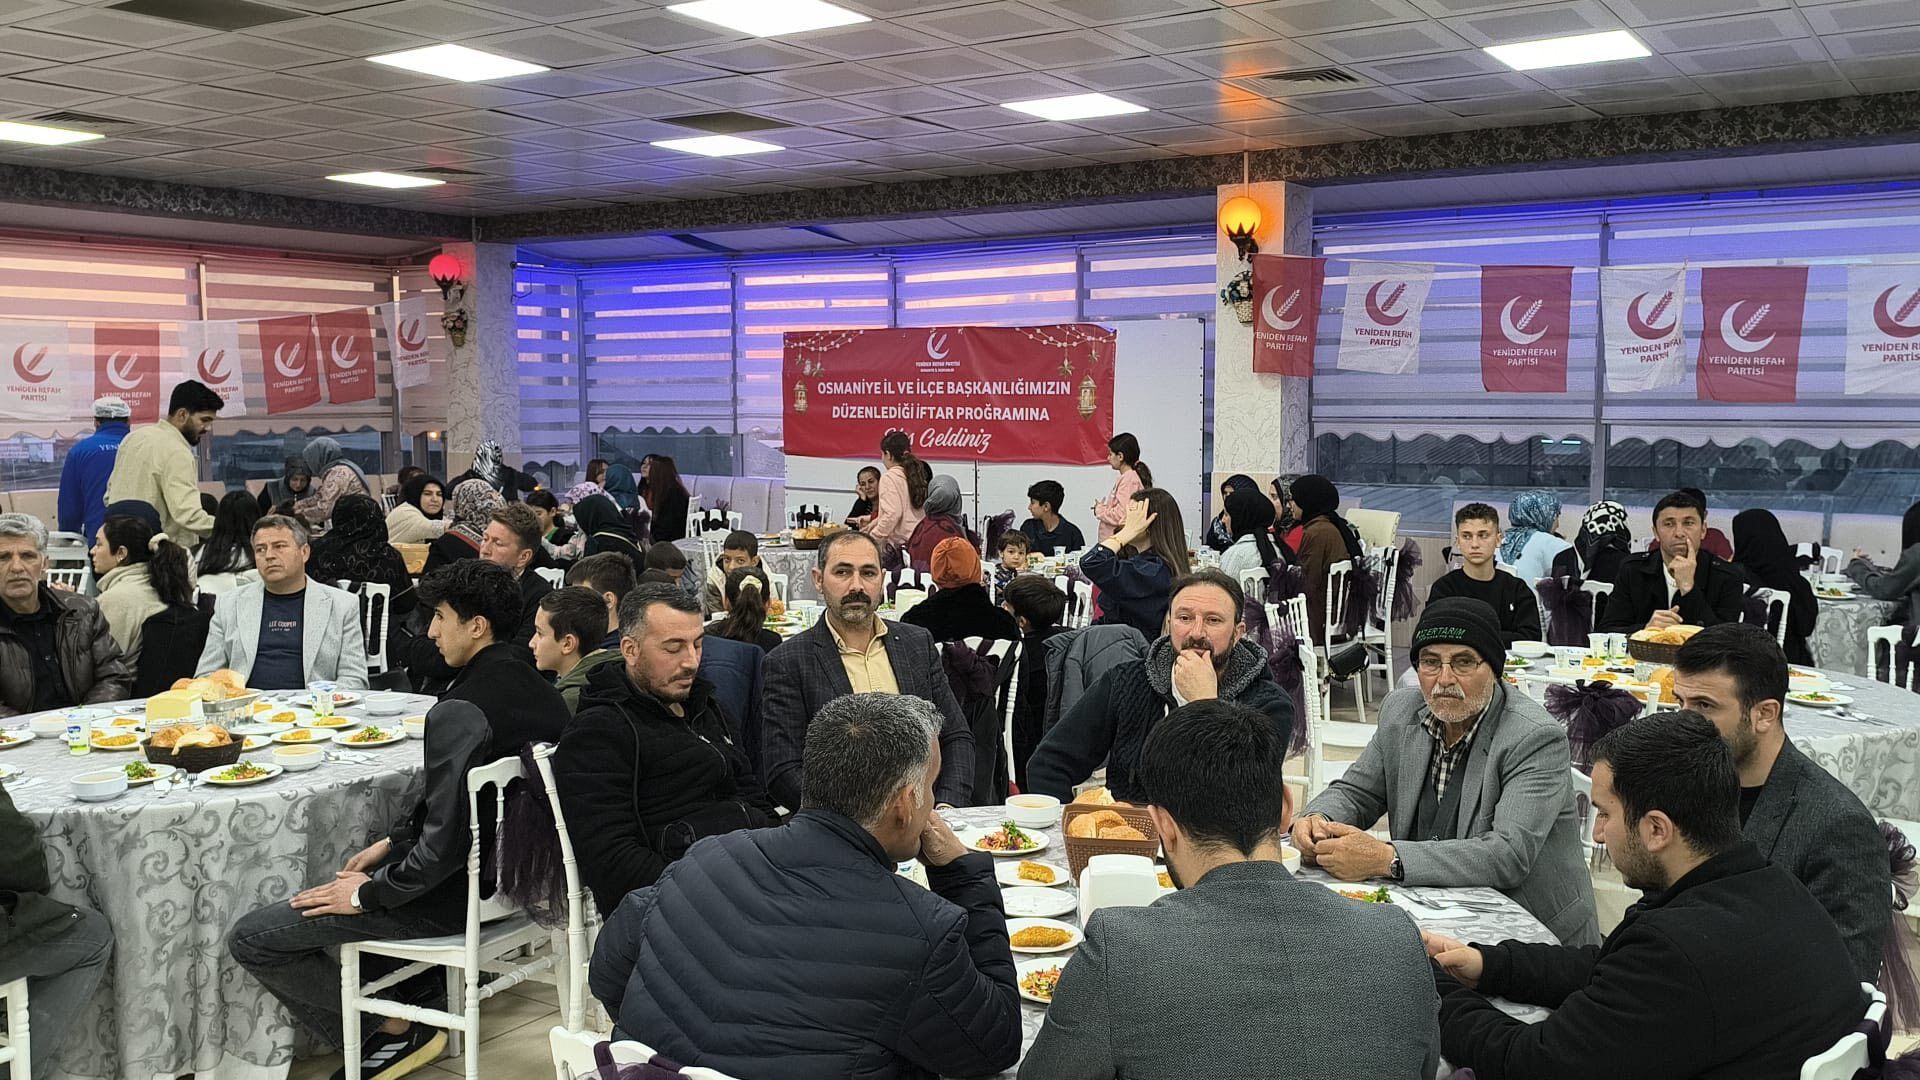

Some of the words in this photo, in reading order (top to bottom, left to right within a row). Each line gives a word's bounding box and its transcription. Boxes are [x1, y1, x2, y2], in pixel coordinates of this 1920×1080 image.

[1354, 327, 1391, 337] YENİDEN
[1492, 346, 1528, 357] YENİDEN
[1528, 348, 1557, 356] REFAH
[1619, 343, 1661, 355] YENİDEN
[1861, 341, 1909, 352] YENİDEN
[1507, 357, 1538, 367] PARTİSİ
[1708, 355, 1751, 365] YENİDEN
[1753, 356, 1785, 366] REFAH
[1883, 352, 1920, 362] PARTİS
[1727, 366, 1765, 376] PARTİSİ
[817, 378, 881, 394] OSMANİYE
[883, 378, 895, 394] İL
[897, 381, 914, 394] VE
[916, 378, 945, 398] İLÇE
[946, 377, 1071, 398] BAŞKANLIĞIMIZIN
[832, 402, 914, 419] DÜZENLEDİĞİ
[916, 403, 954, 420] İFTAR
[956, 403, 1050, 421] PROĞRAMINA
[919, 427, 992, 454] Geldiniz
